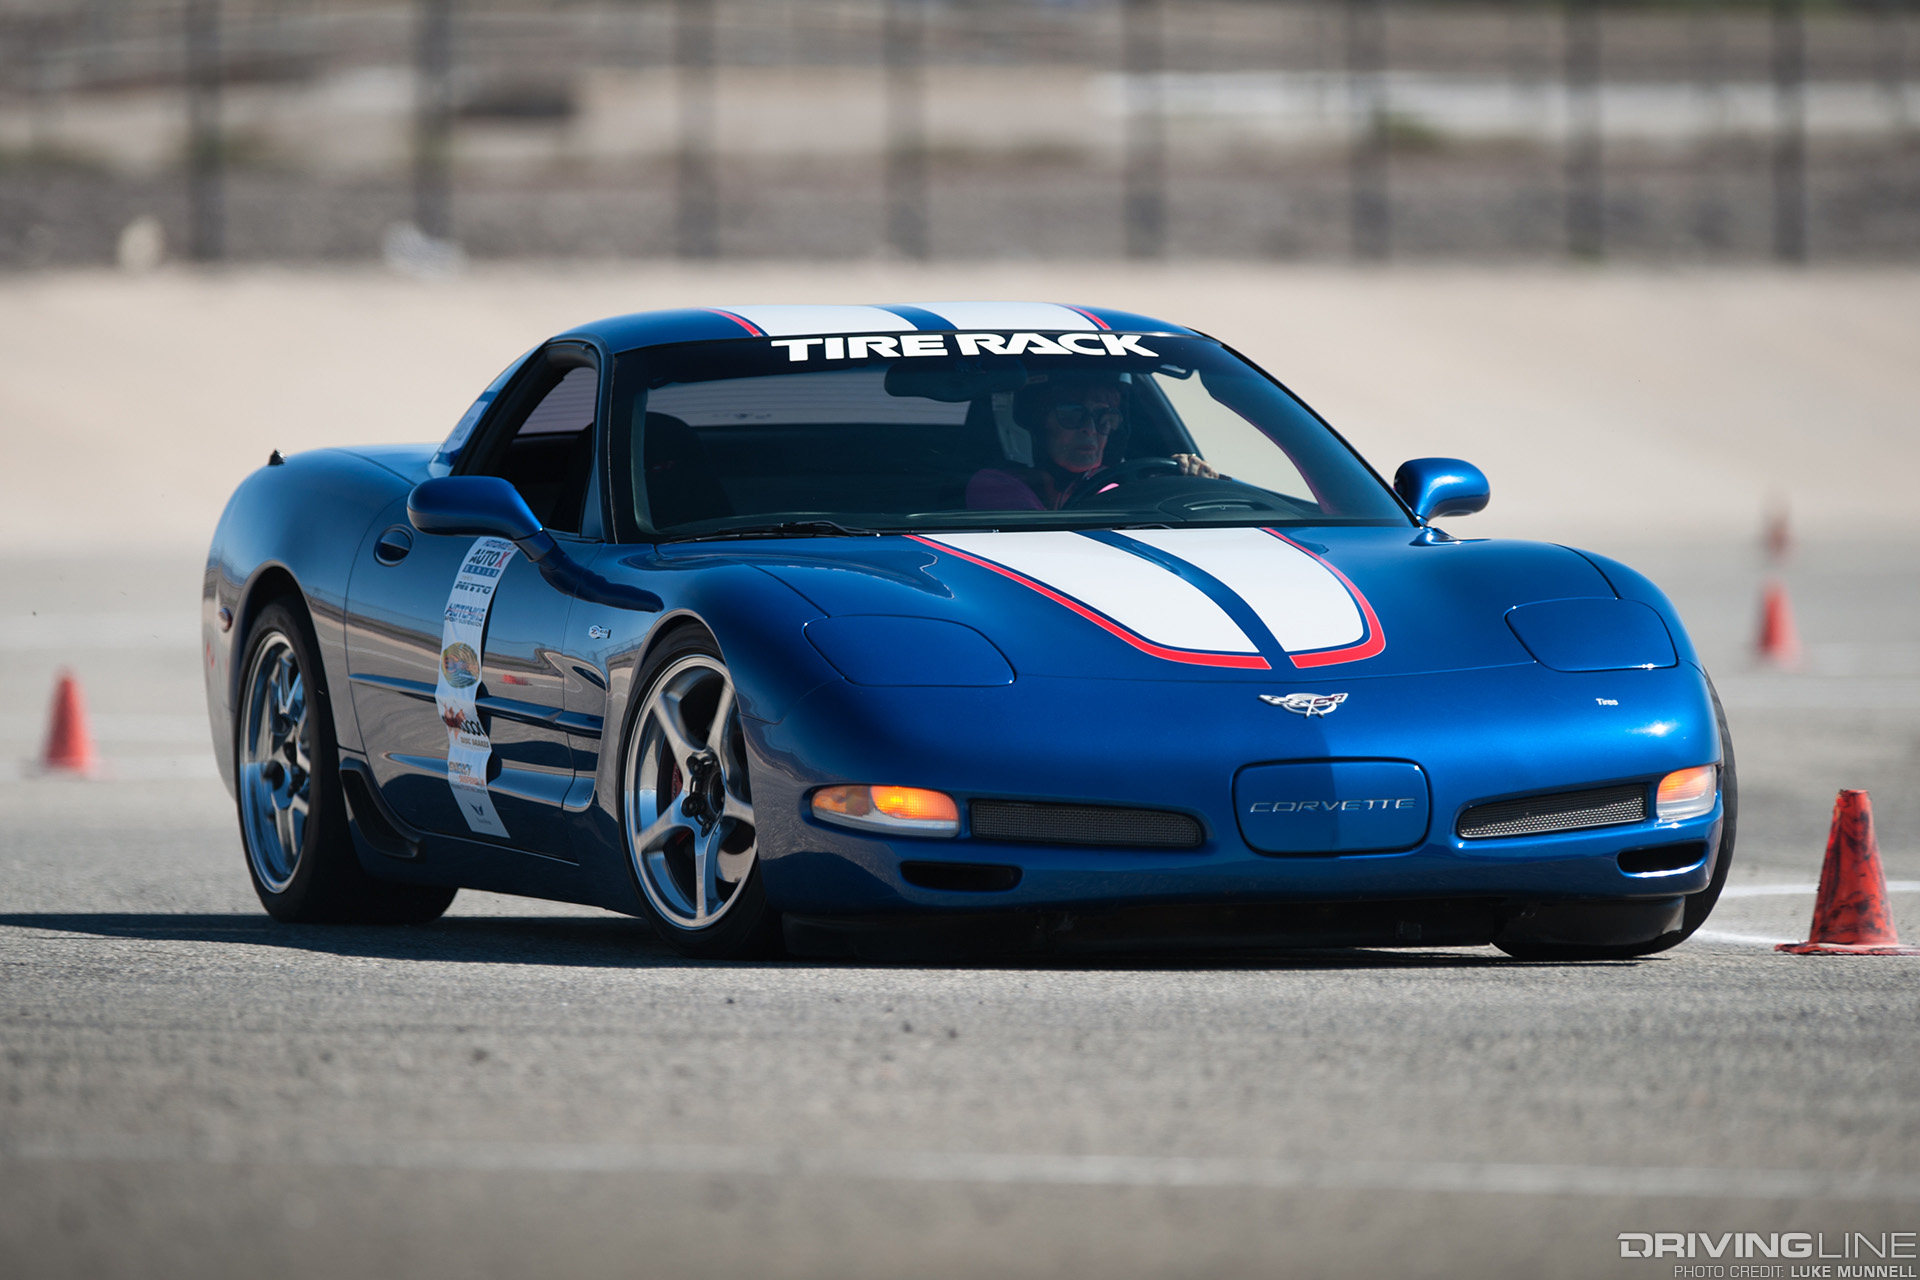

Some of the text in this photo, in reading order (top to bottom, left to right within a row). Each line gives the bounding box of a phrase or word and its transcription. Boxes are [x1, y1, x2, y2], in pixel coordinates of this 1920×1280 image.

[771, 333, 1159, 362] TIRE RACK
[463, 564, 499, 577] SERIES
[455, 581, 492, 595] NITTO
[1250, 798, 1415, 813] CORVETTE
